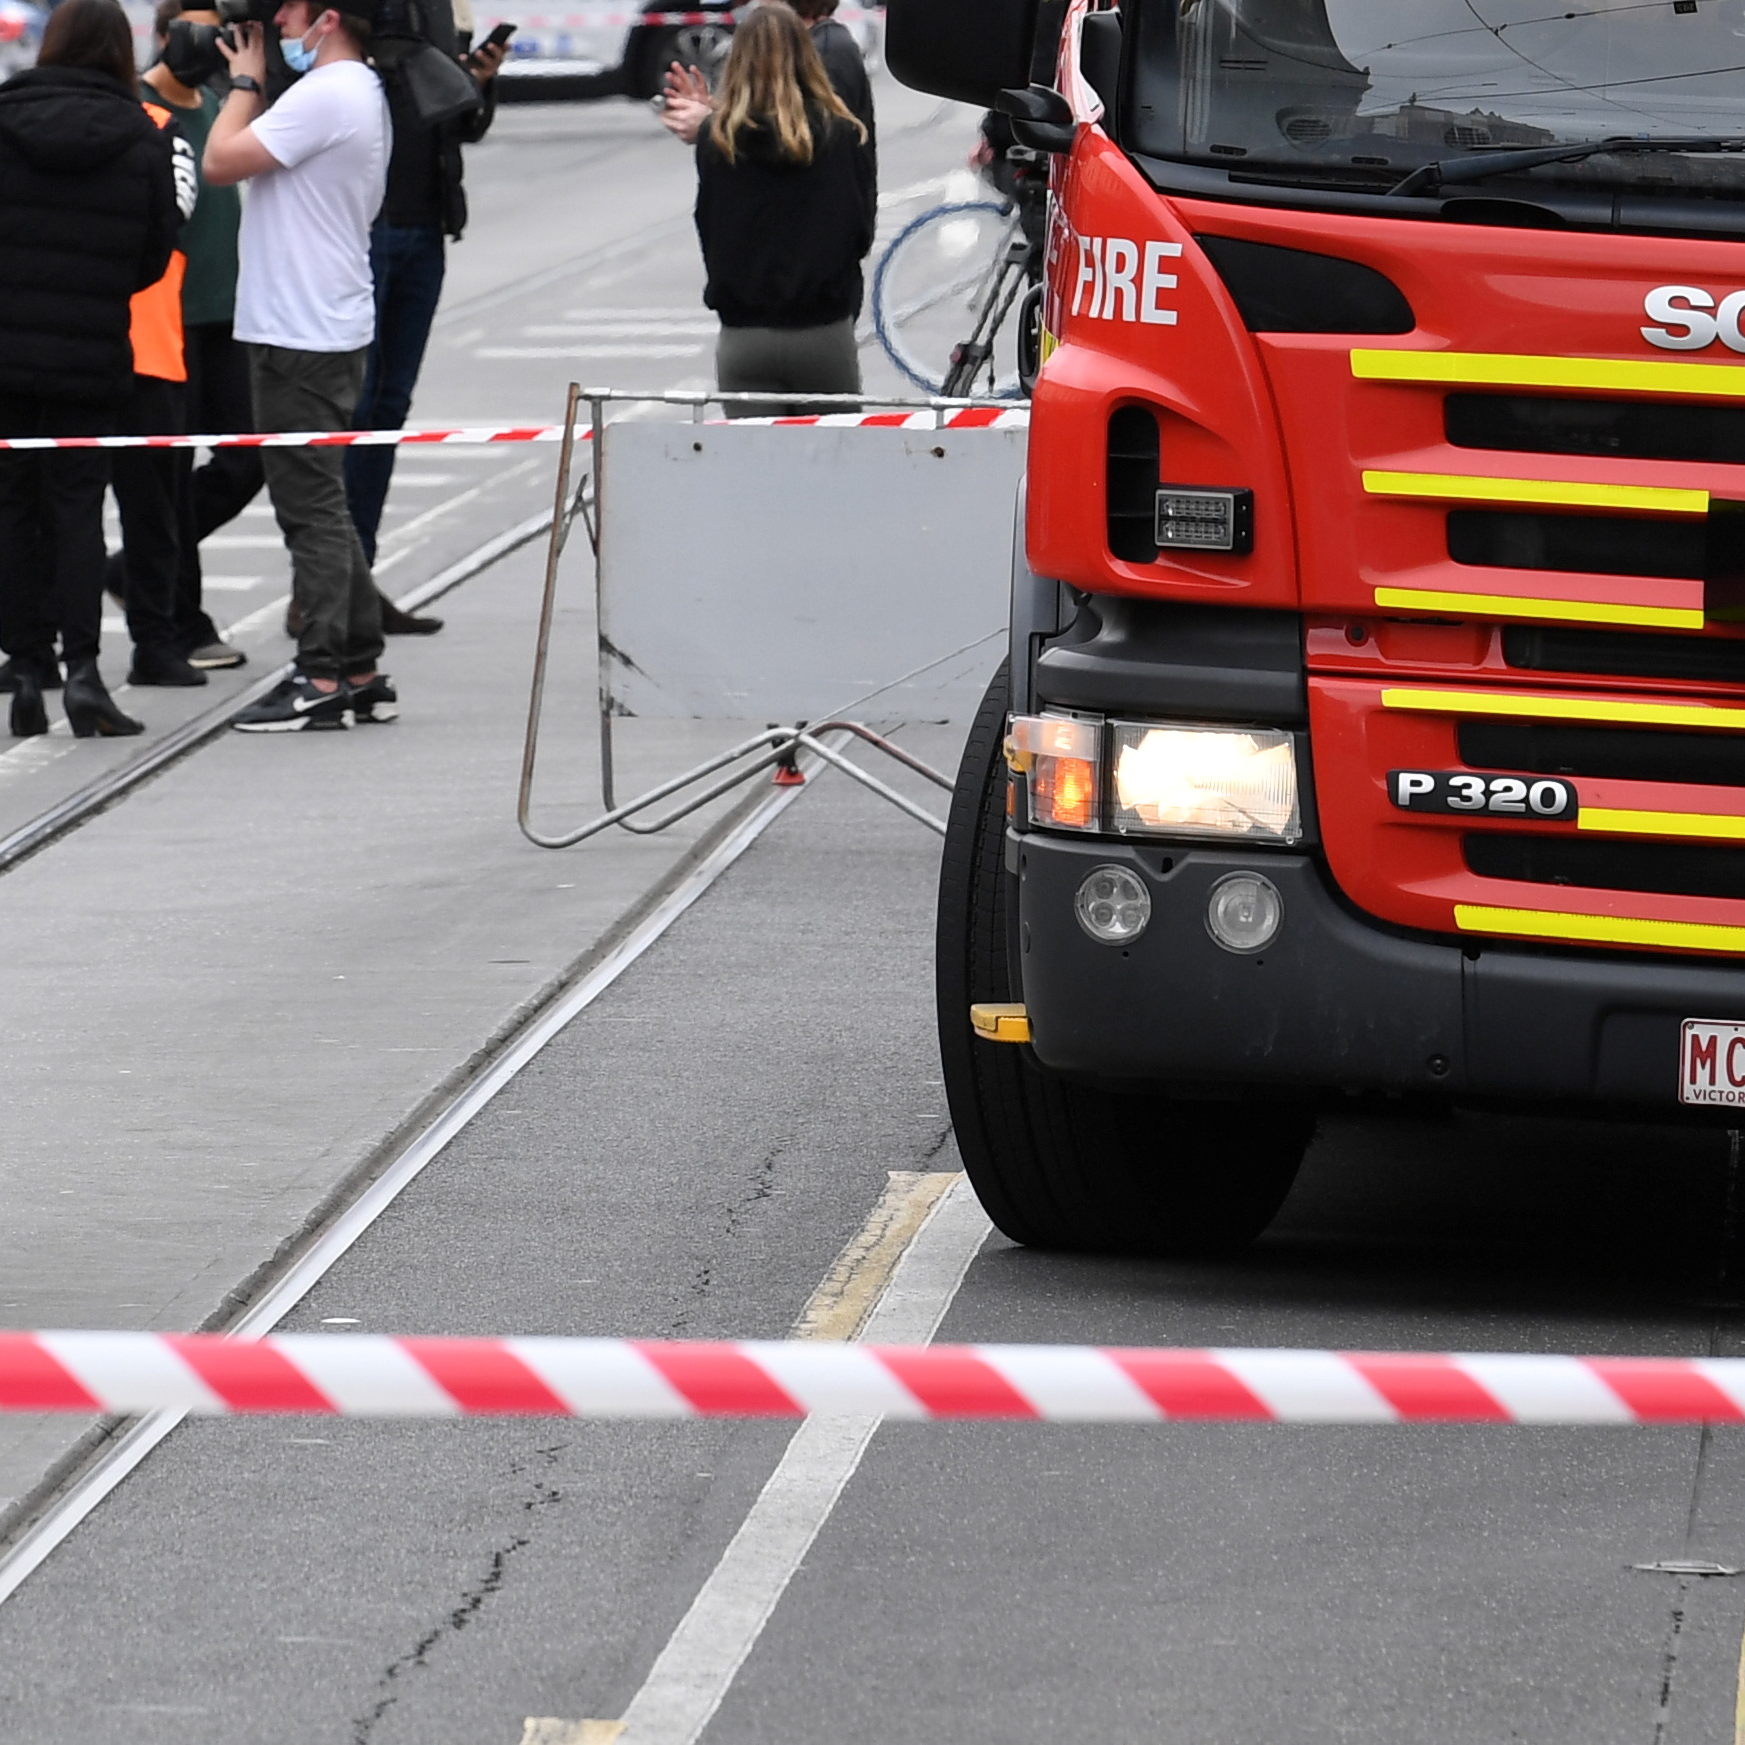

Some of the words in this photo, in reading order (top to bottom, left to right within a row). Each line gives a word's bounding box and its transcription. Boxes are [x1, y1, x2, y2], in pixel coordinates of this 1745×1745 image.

[1071, 235, 1183, 326] FIRE
[1397, 772, 1435, 806] P
[1446, 775, 1568, 815] 320
